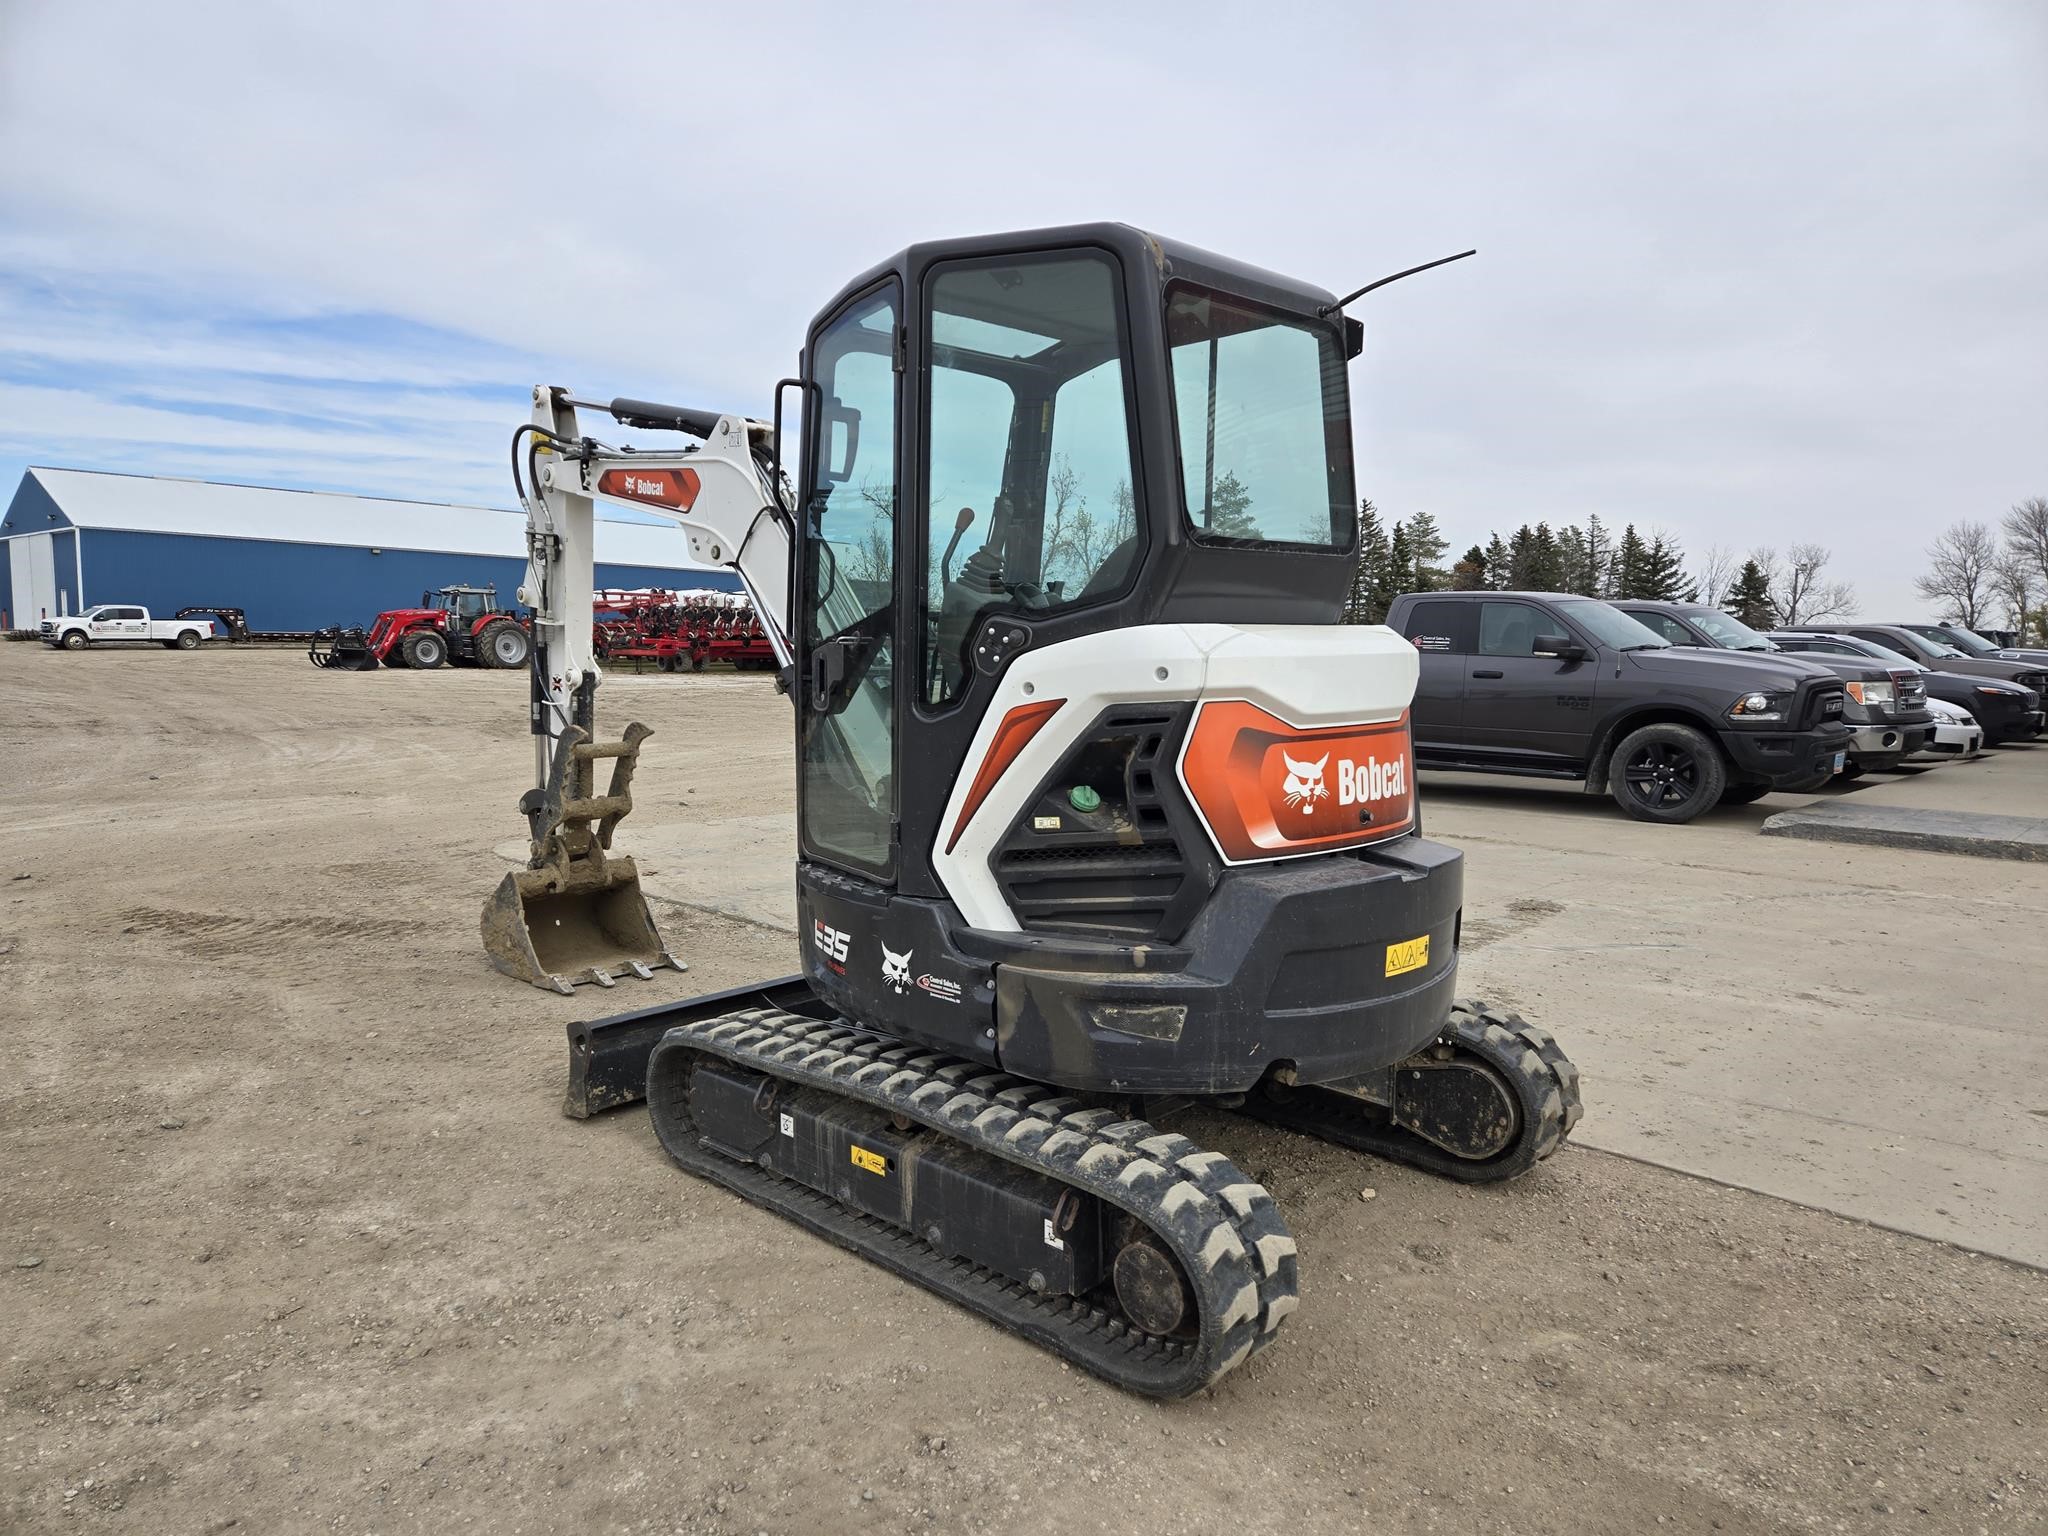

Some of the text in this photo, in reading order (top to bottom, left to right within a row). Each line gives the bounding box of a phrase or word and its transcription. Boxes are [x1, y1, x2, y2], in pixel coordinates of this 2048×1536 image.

[637, 479, 664, 496] Bobcat
[1337, 753, 1406, 805] Bobcat
[814, 918, 851, 963] E35
